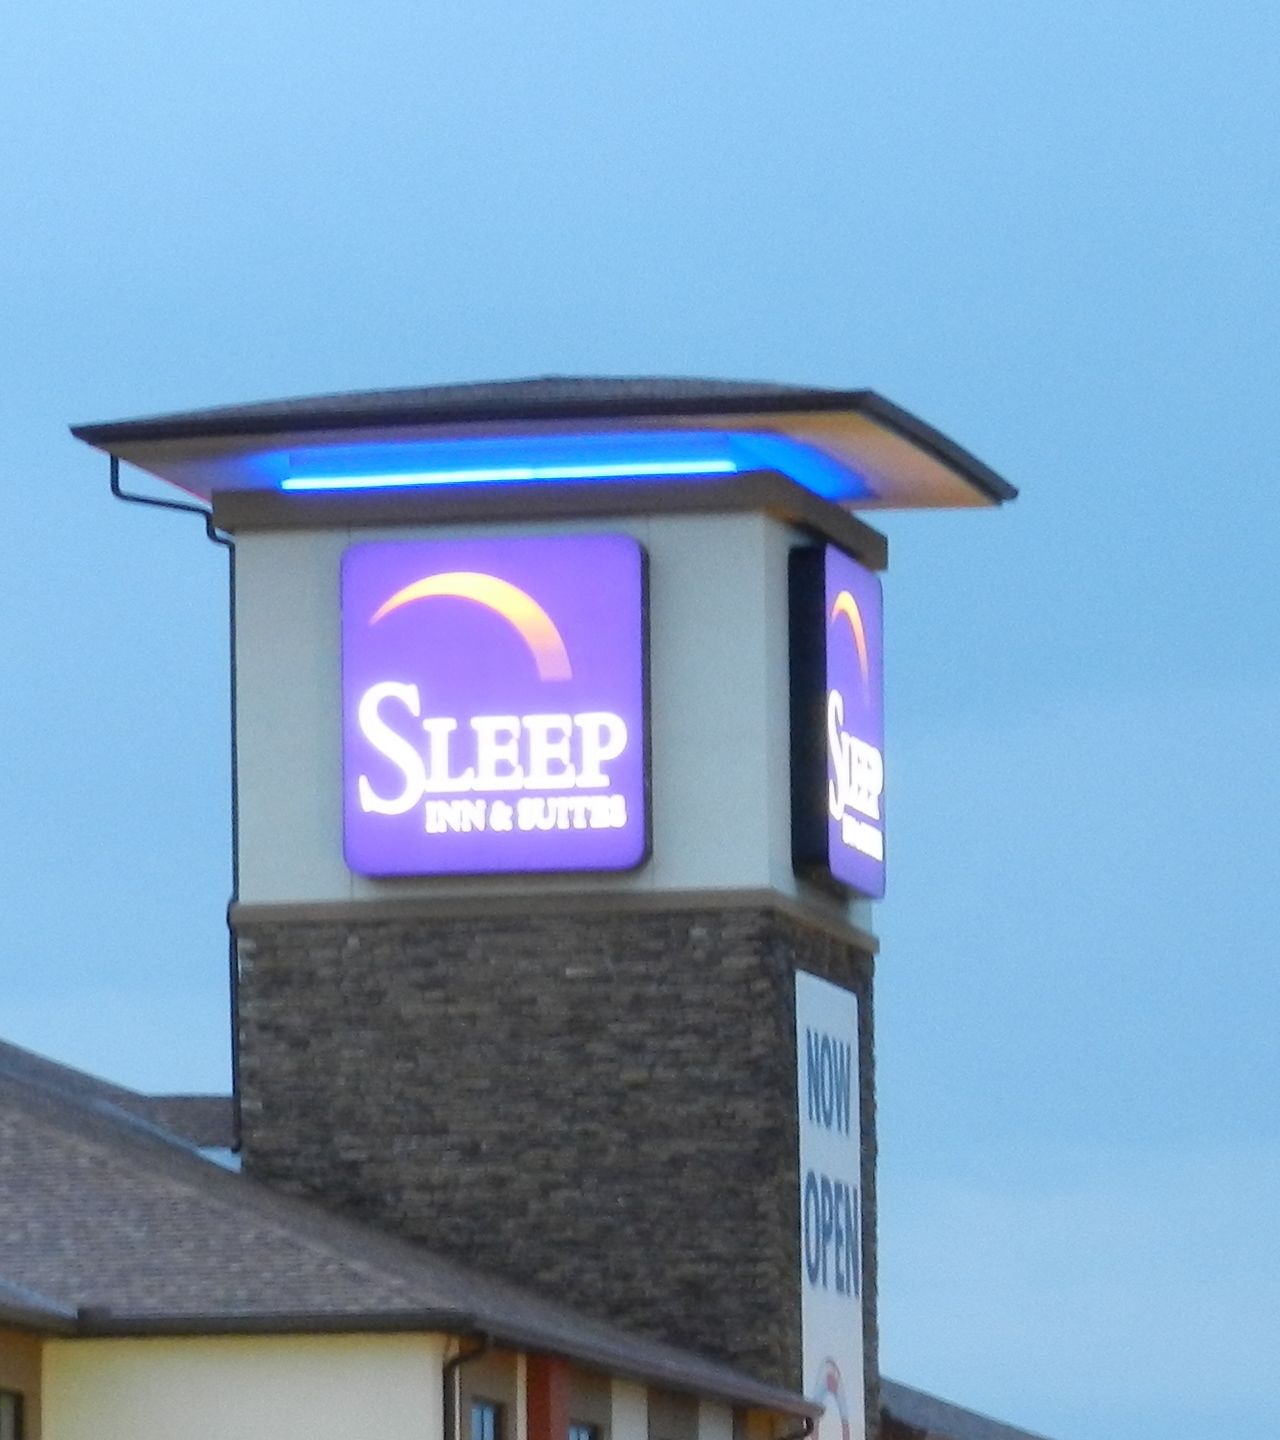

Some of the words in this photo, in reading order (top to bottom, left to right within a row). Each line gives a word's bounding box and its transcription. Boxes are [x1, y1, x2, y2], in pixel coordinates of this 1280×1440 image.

[358, 681, 628, 815] SLEEP
[425, 799, 487, 834] INN
[806, 1025, 851, 1137] NOW
[804, 1167, 860, 1298] OPEN
